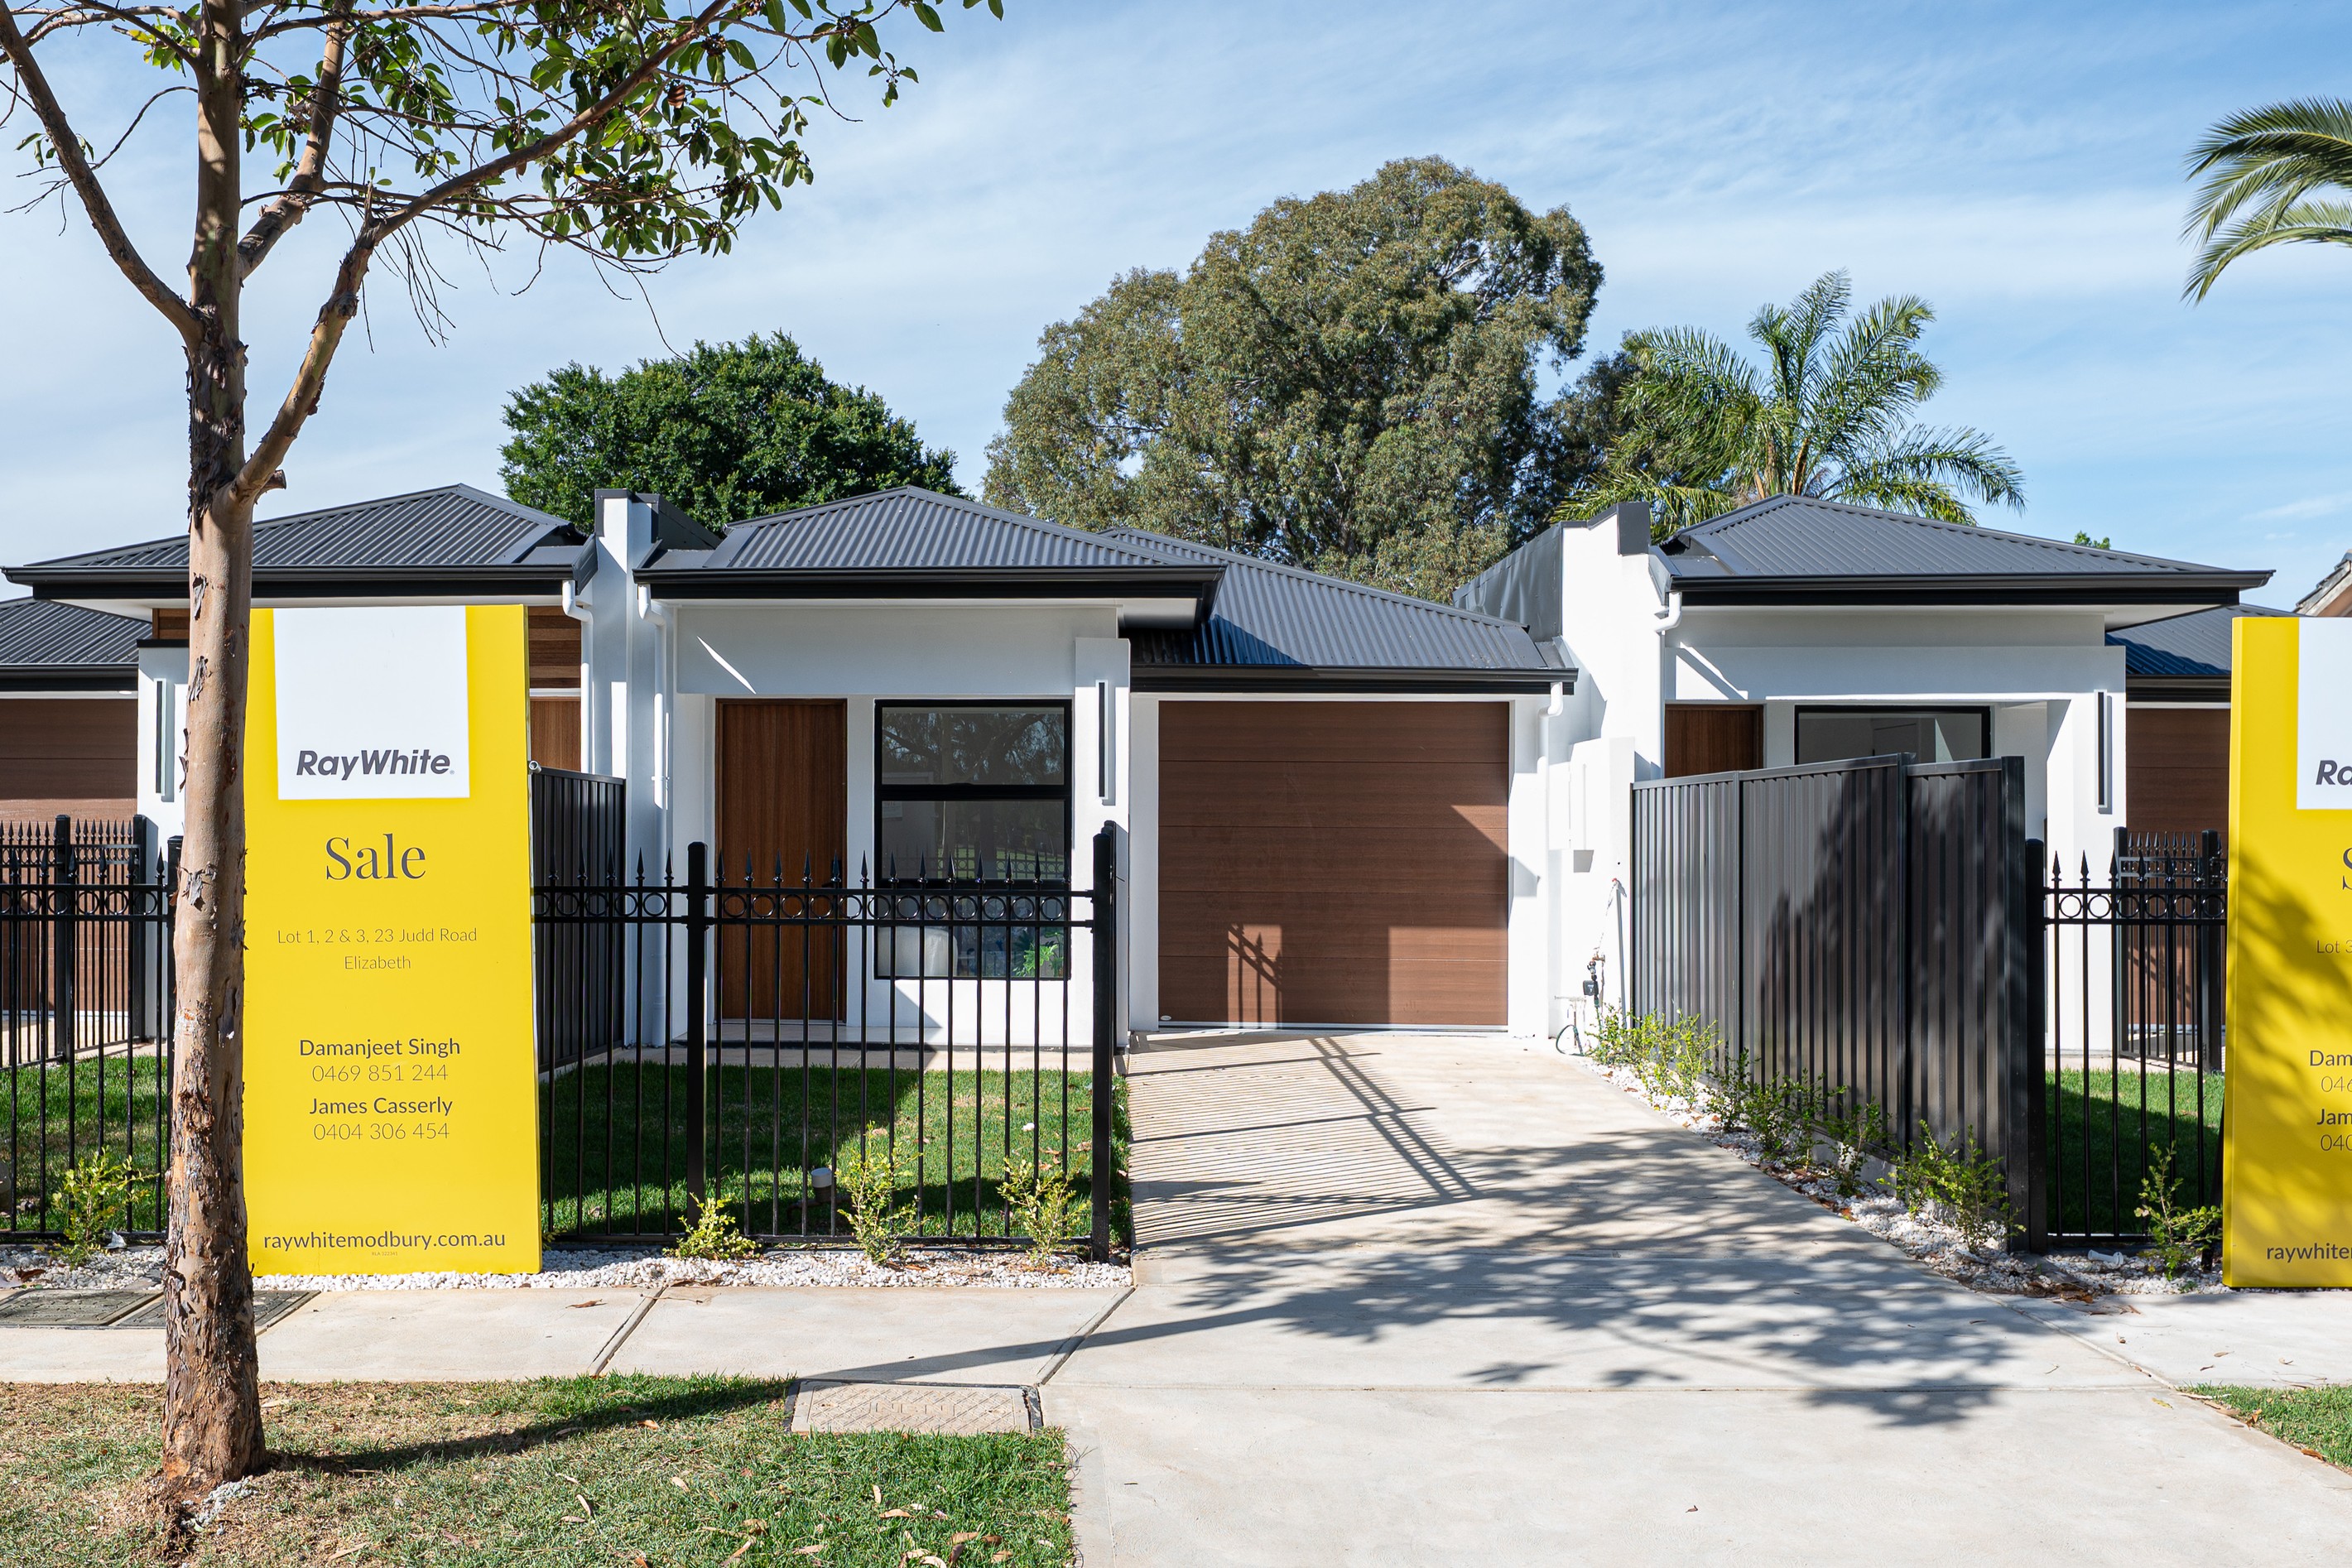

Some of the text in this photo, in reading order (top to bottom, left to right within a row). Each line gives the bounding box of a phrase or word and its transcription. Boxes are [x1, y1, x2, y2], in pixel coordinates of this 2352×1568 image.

[296, 748, 451, 782] RayWhite
[325, 832, 426, 881] Sale
[277, 927, 478, 946] Lot 1, 2 & 3, 23 Judd Road
[2316, 939, 2341, 954] Lot
[344, 955, 412, 970] Elizabeth
[300, 1037, 461, 1060] Damanjeet Singh
[2310, 1049, 2352, 1066] Dam
[311, 1064, 449, 1082] 0469 851 244
[309, 1095, 454, 1117] James Casserly
[313, 1122, 450, 1141] 0404 306 454
[263, 1230, 506, 1253] raywhitemodbury.com.au
[2267, 1242, 2352, 1263] raywhite
